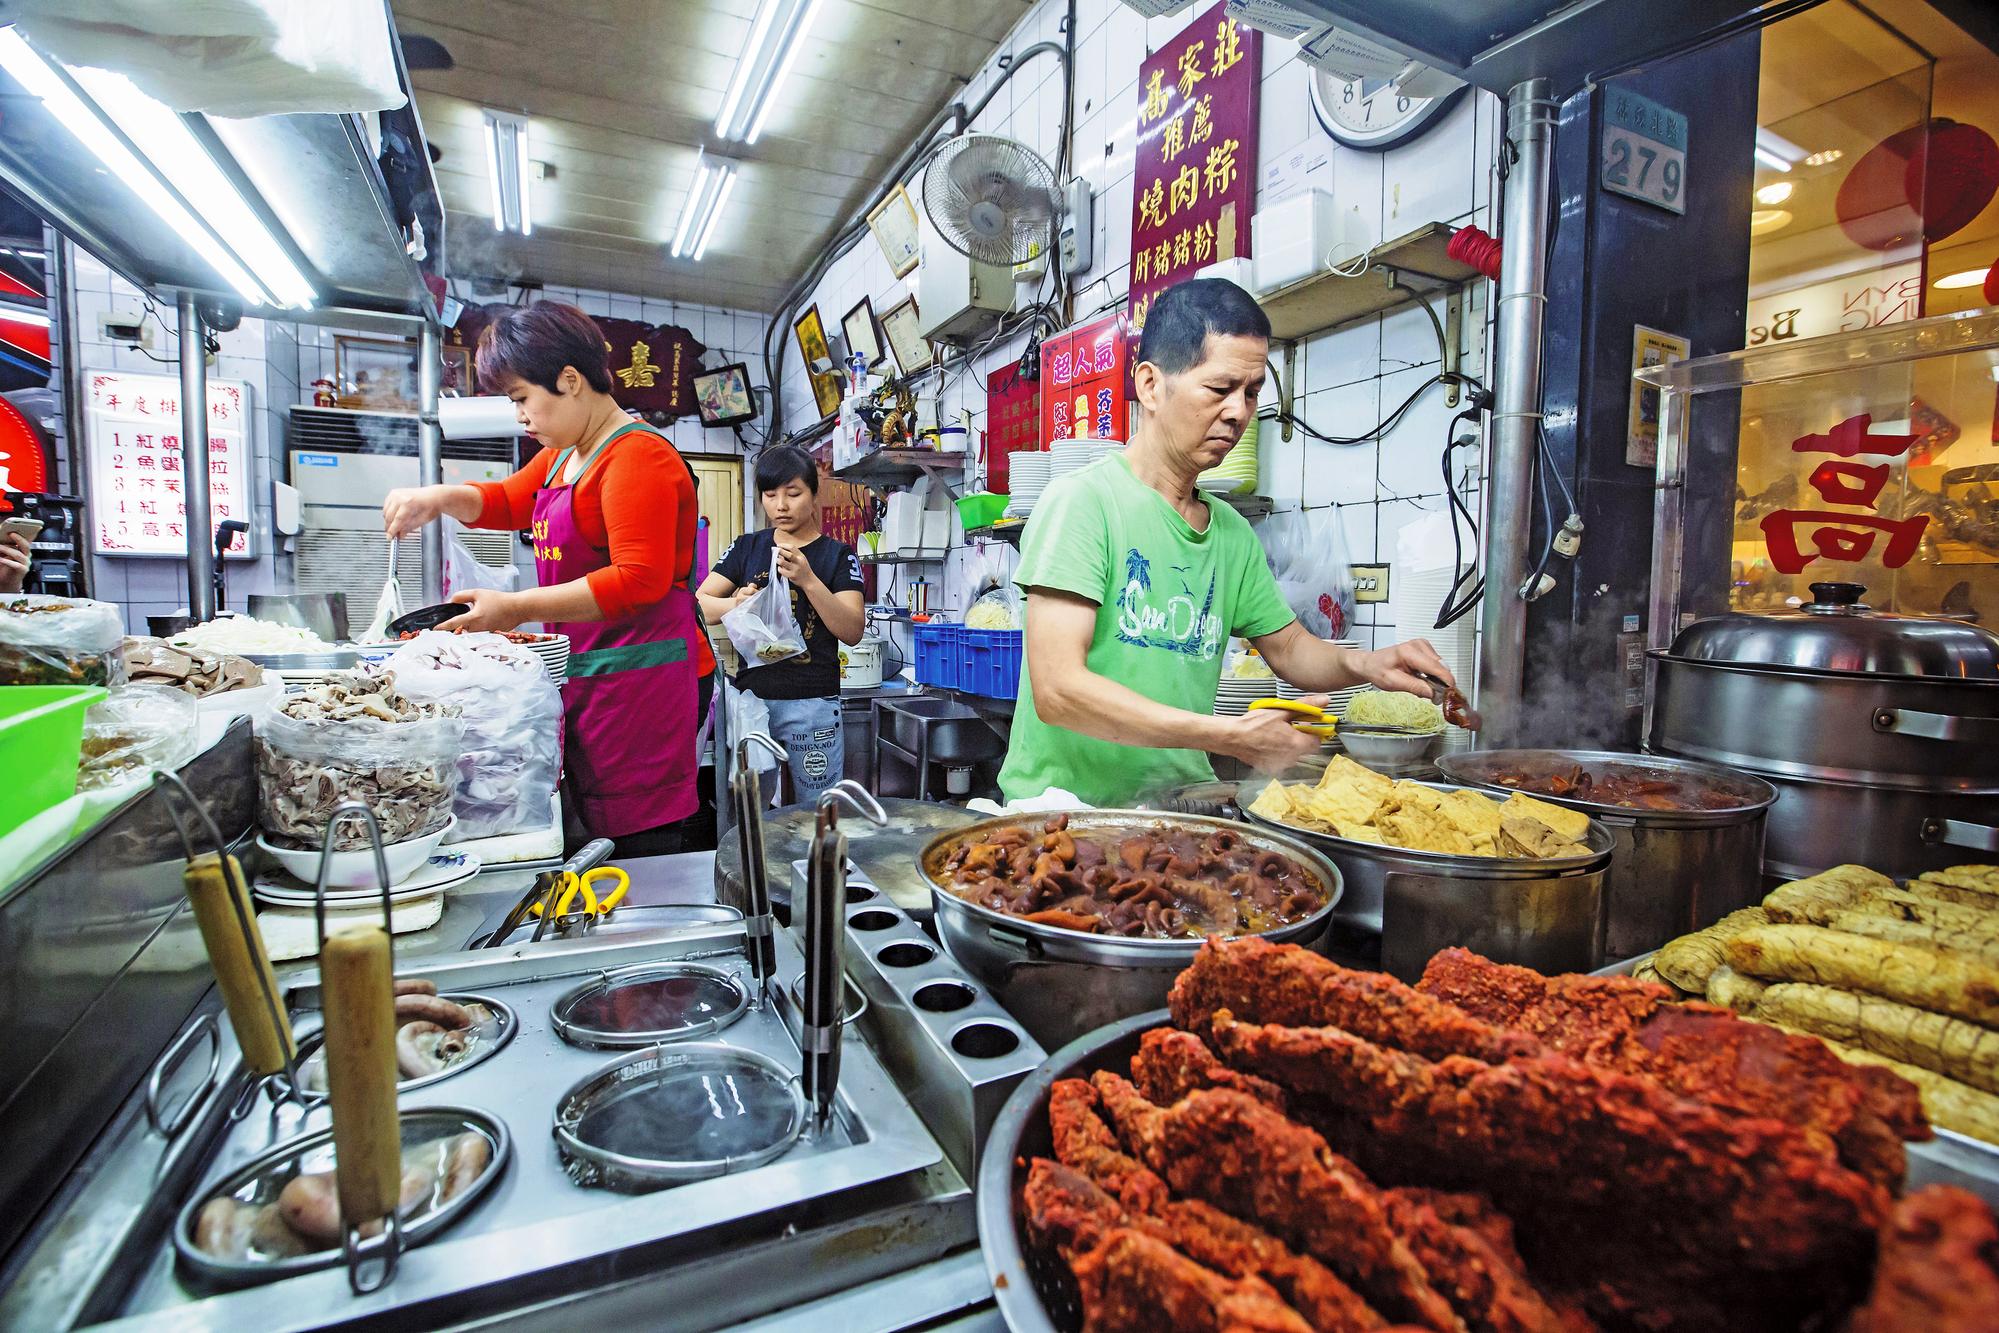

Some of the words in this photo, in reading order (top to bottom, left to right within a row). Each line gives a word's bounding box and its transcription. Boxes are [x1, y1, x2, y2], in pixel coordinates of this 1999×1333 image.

[1141, 18, 1244, 127] 高家莊
[1343, 83, 1354, 104] 8
[1161, 93, 1213, 163] 推薦
[1362, 99, 1374, 122] 7
[1137, 138, 1240, 232] 燒肉粽
[1607, 138, 1682, 202] 279
[106, 394, 230, 420] 年度排榜
[1760, 414, 1931, 575] 高
[792, 733, 808, 741] TOP
